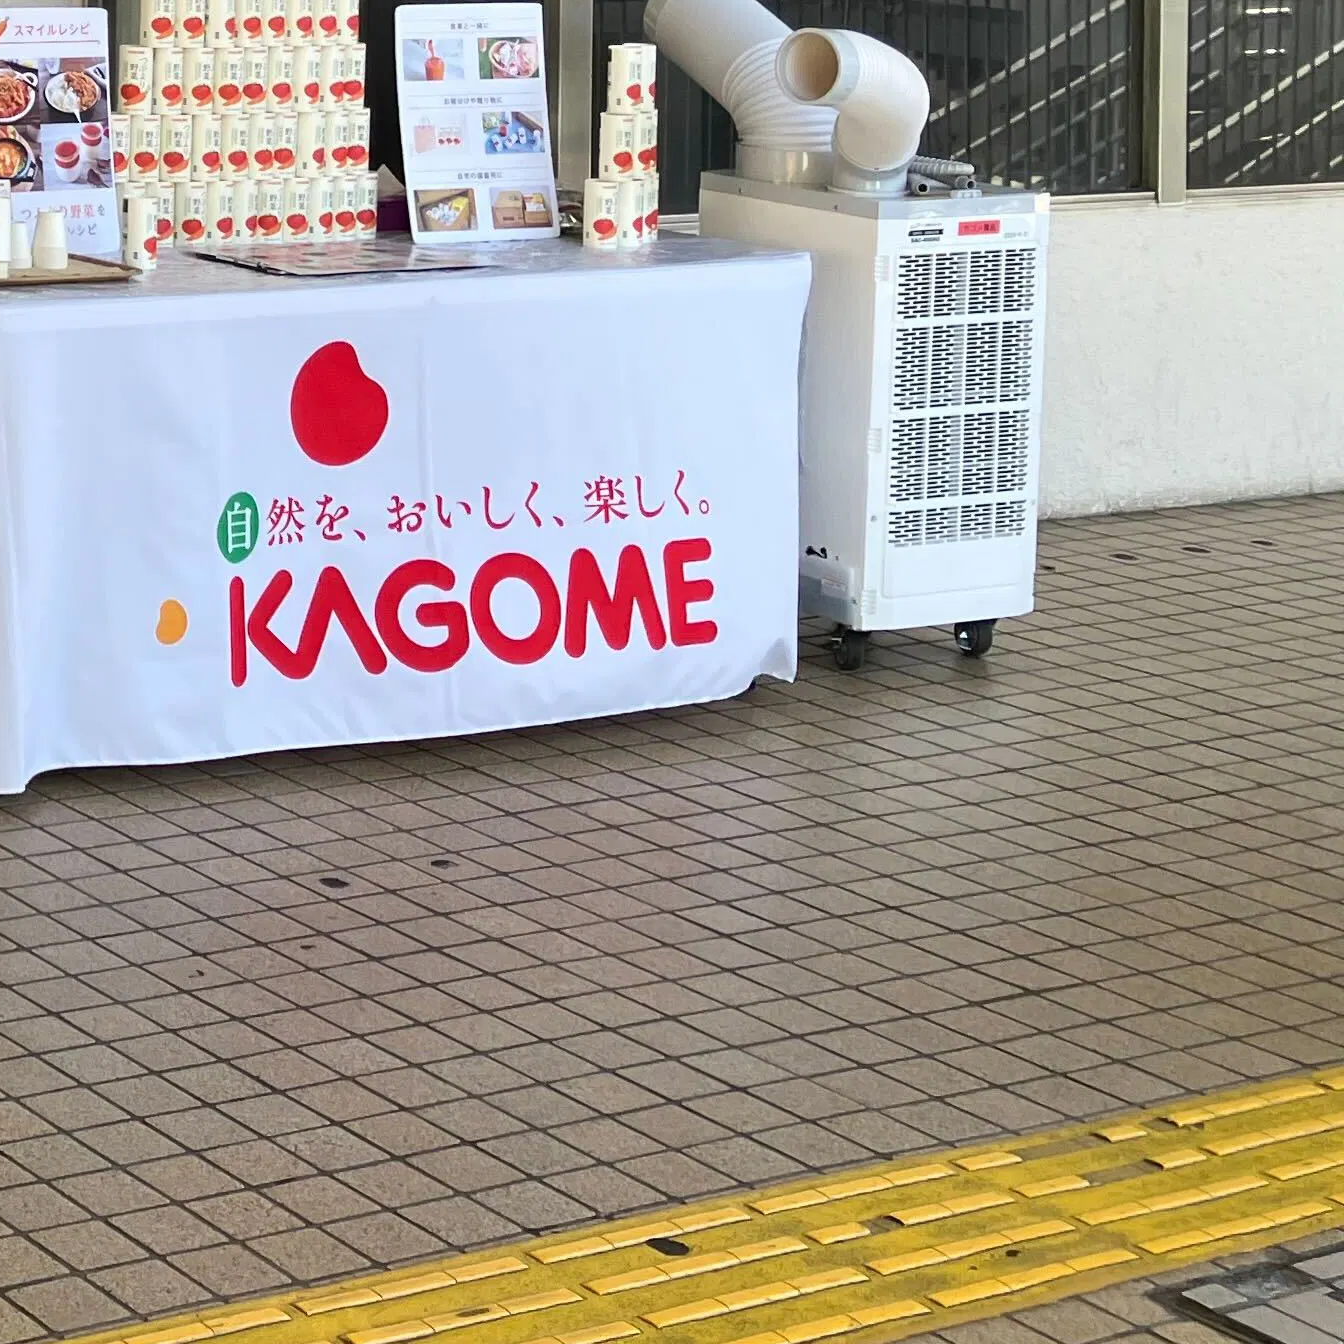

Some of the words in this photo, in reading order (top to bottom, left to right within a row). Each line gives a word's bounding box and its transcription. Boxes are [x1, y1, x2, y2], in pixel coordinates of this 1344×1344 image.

[13, 22, 90, 37] スマイルレシピ
[229, 536, 719, 688] KAGOME
